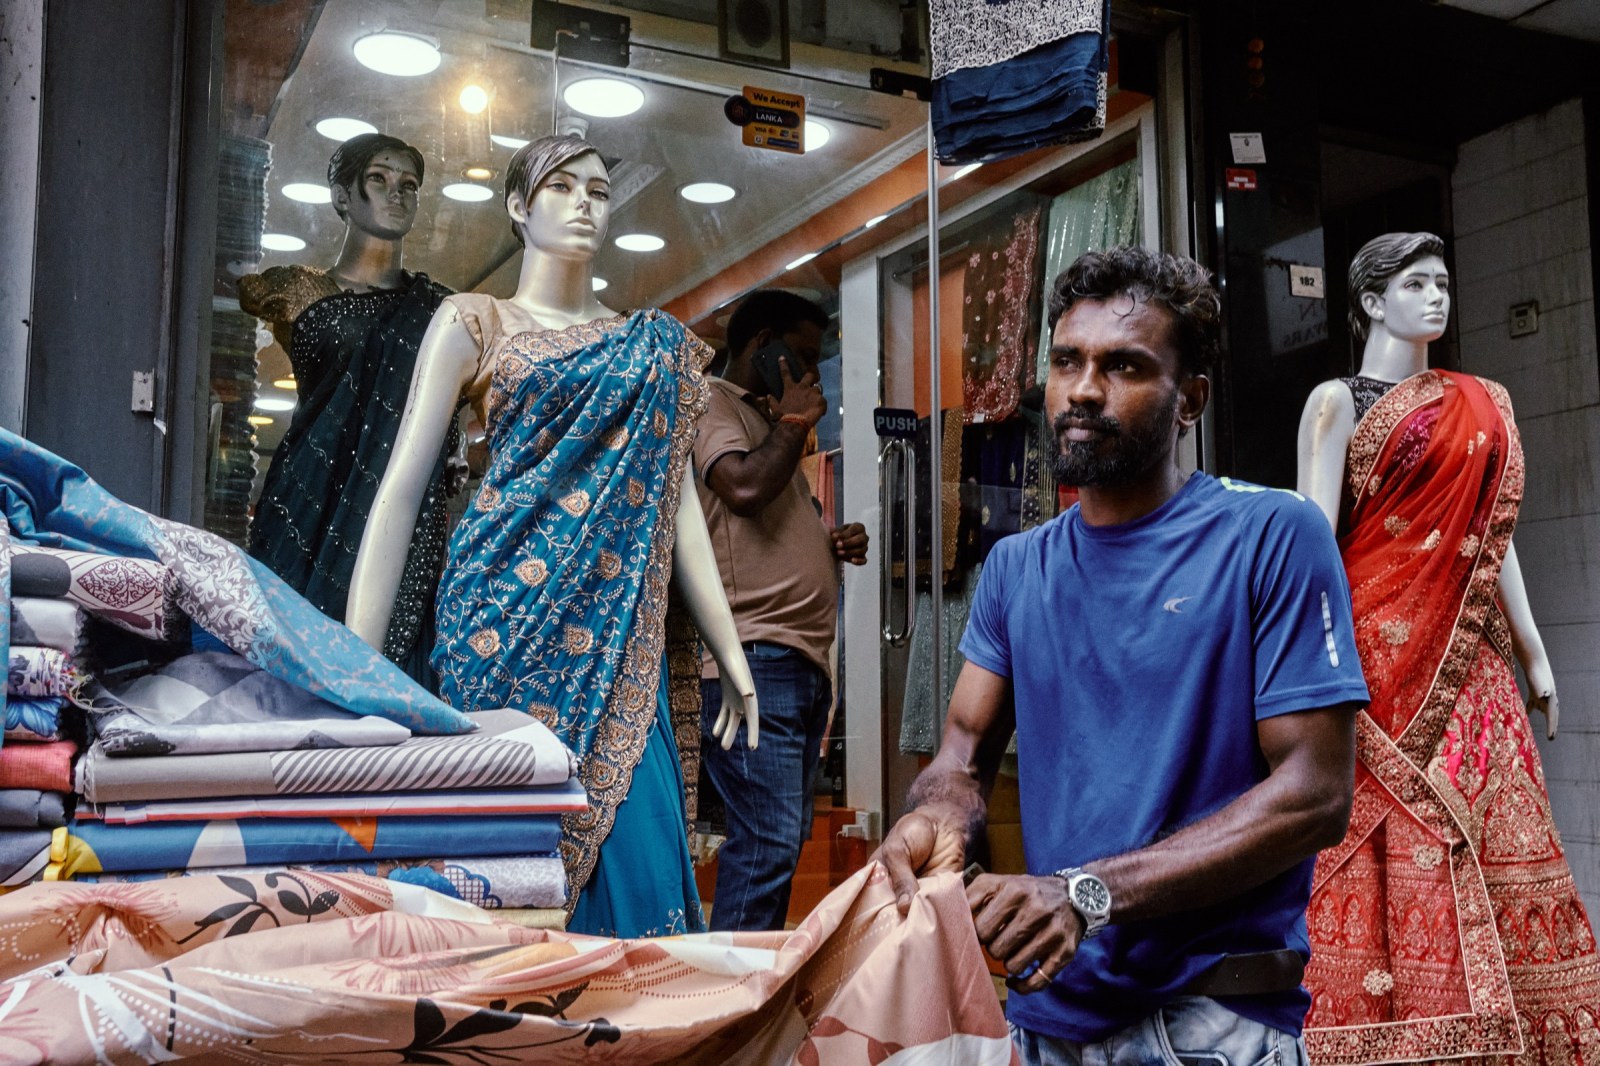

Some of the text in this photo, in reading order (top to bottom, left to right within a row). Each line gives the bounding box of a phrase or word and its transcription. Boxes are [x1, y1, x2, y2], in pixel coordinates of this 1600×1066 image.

[754, 93, 800, 108] We Accept
[756, 112, 783, 123] LANKA
[1299, 275, 1315, 287] 182
[876, 415, 917, 431] PUSH
